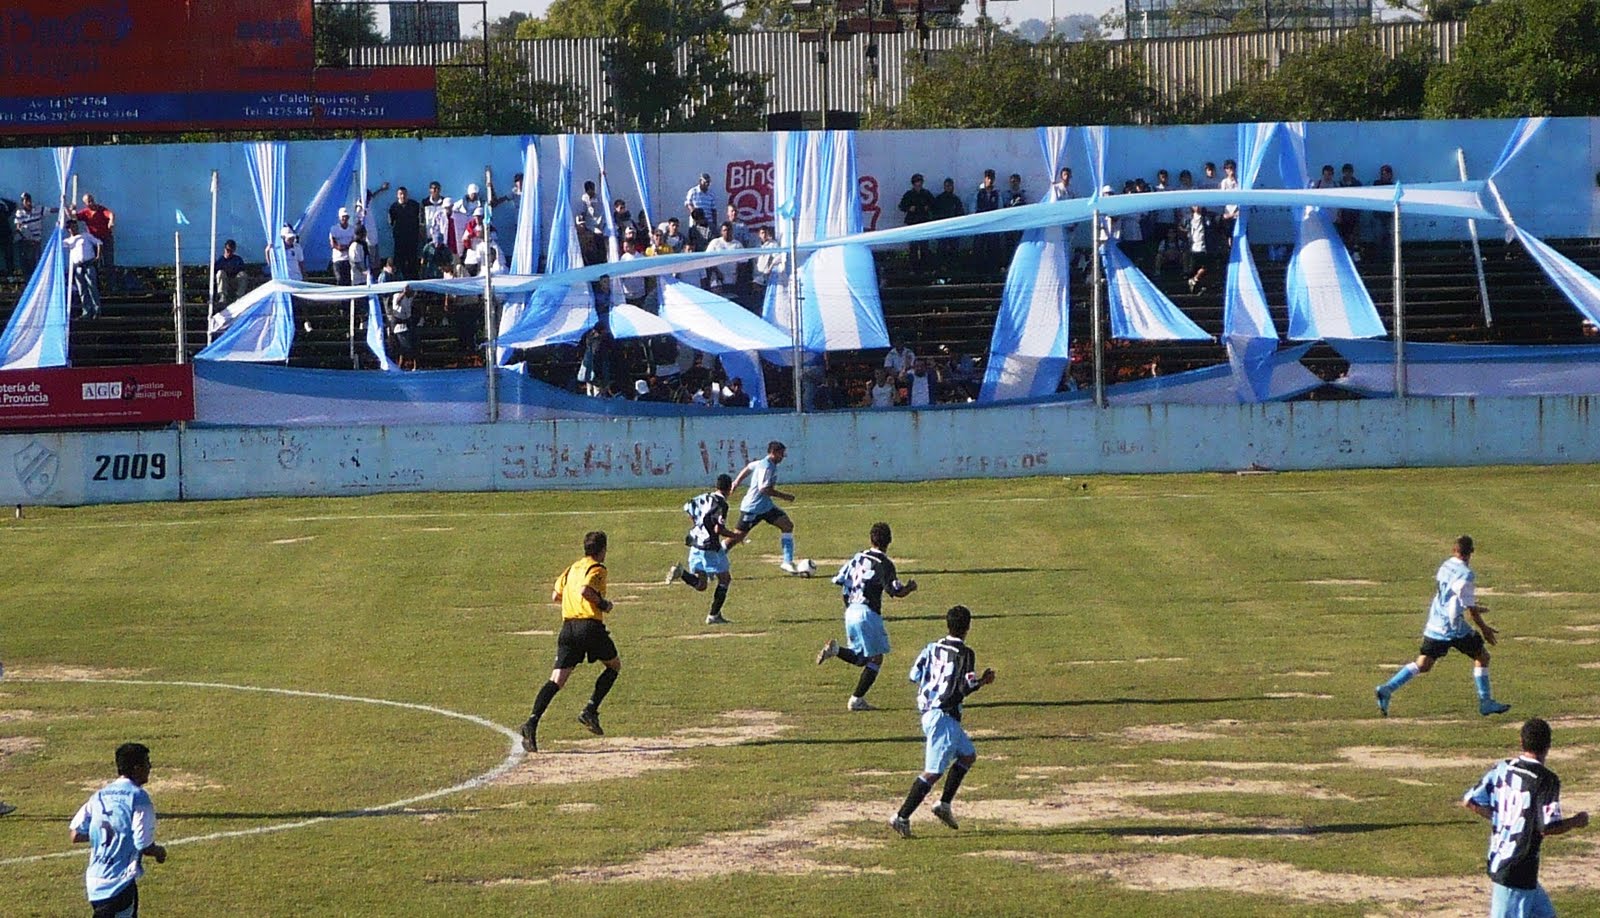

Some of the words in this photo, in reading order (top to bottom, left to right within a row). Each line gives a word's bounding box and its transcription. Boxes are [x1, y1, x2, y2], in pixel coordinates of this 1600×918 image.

[28, 381, 41, 391] de
[3, 390, 49, 404] Provincia
[157, 390, 182, 399] Group
[93, 453, 166, 481] 2009
